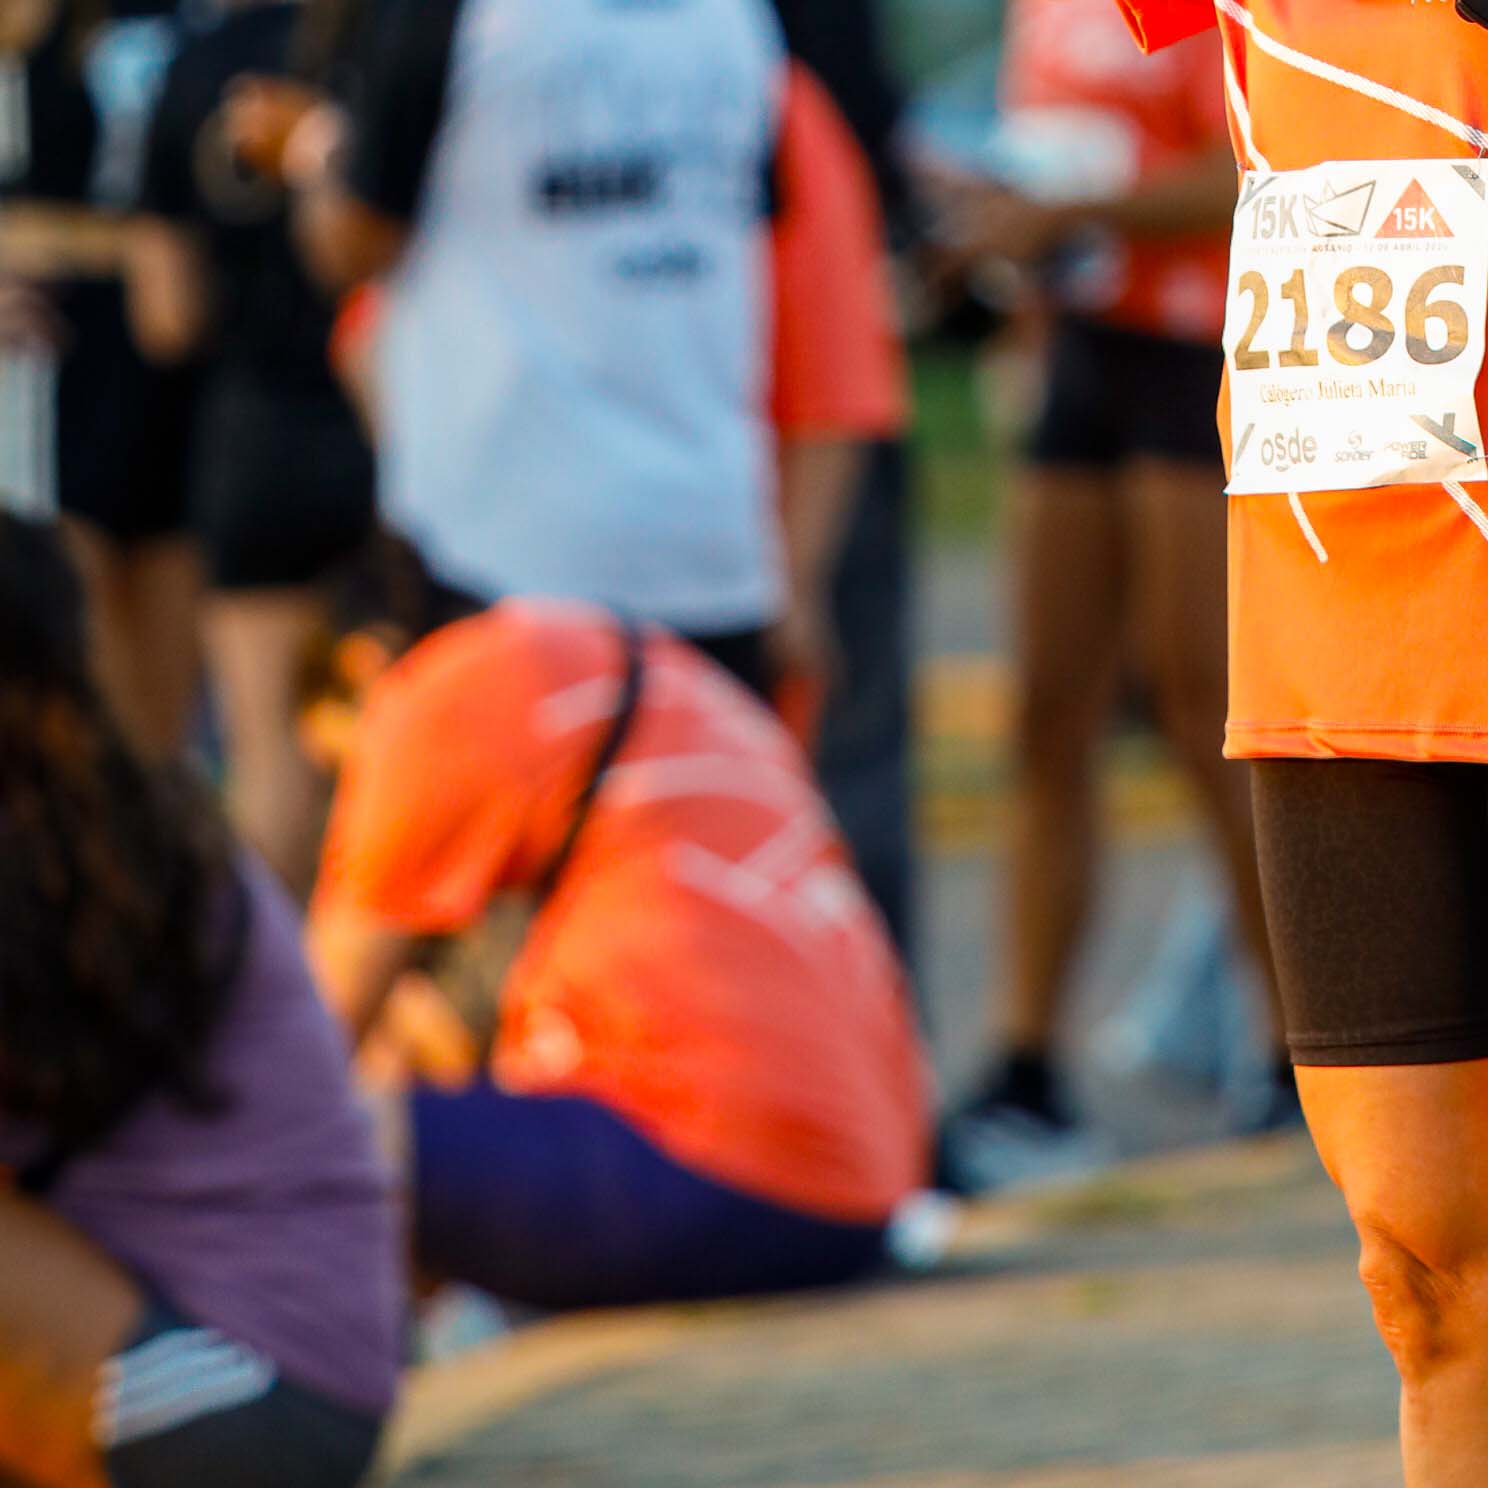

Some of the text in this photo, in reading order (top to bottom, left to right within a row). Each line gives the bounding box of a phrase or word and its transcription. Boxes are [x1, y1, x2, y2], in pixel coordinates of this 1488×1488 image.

[1250, 194, 1298, 239] 15K
[1392, 207, 1436, 232] 15K
[1234, 265, 1469, 370] 2186
[1261, 427, 1318, 465] osde
